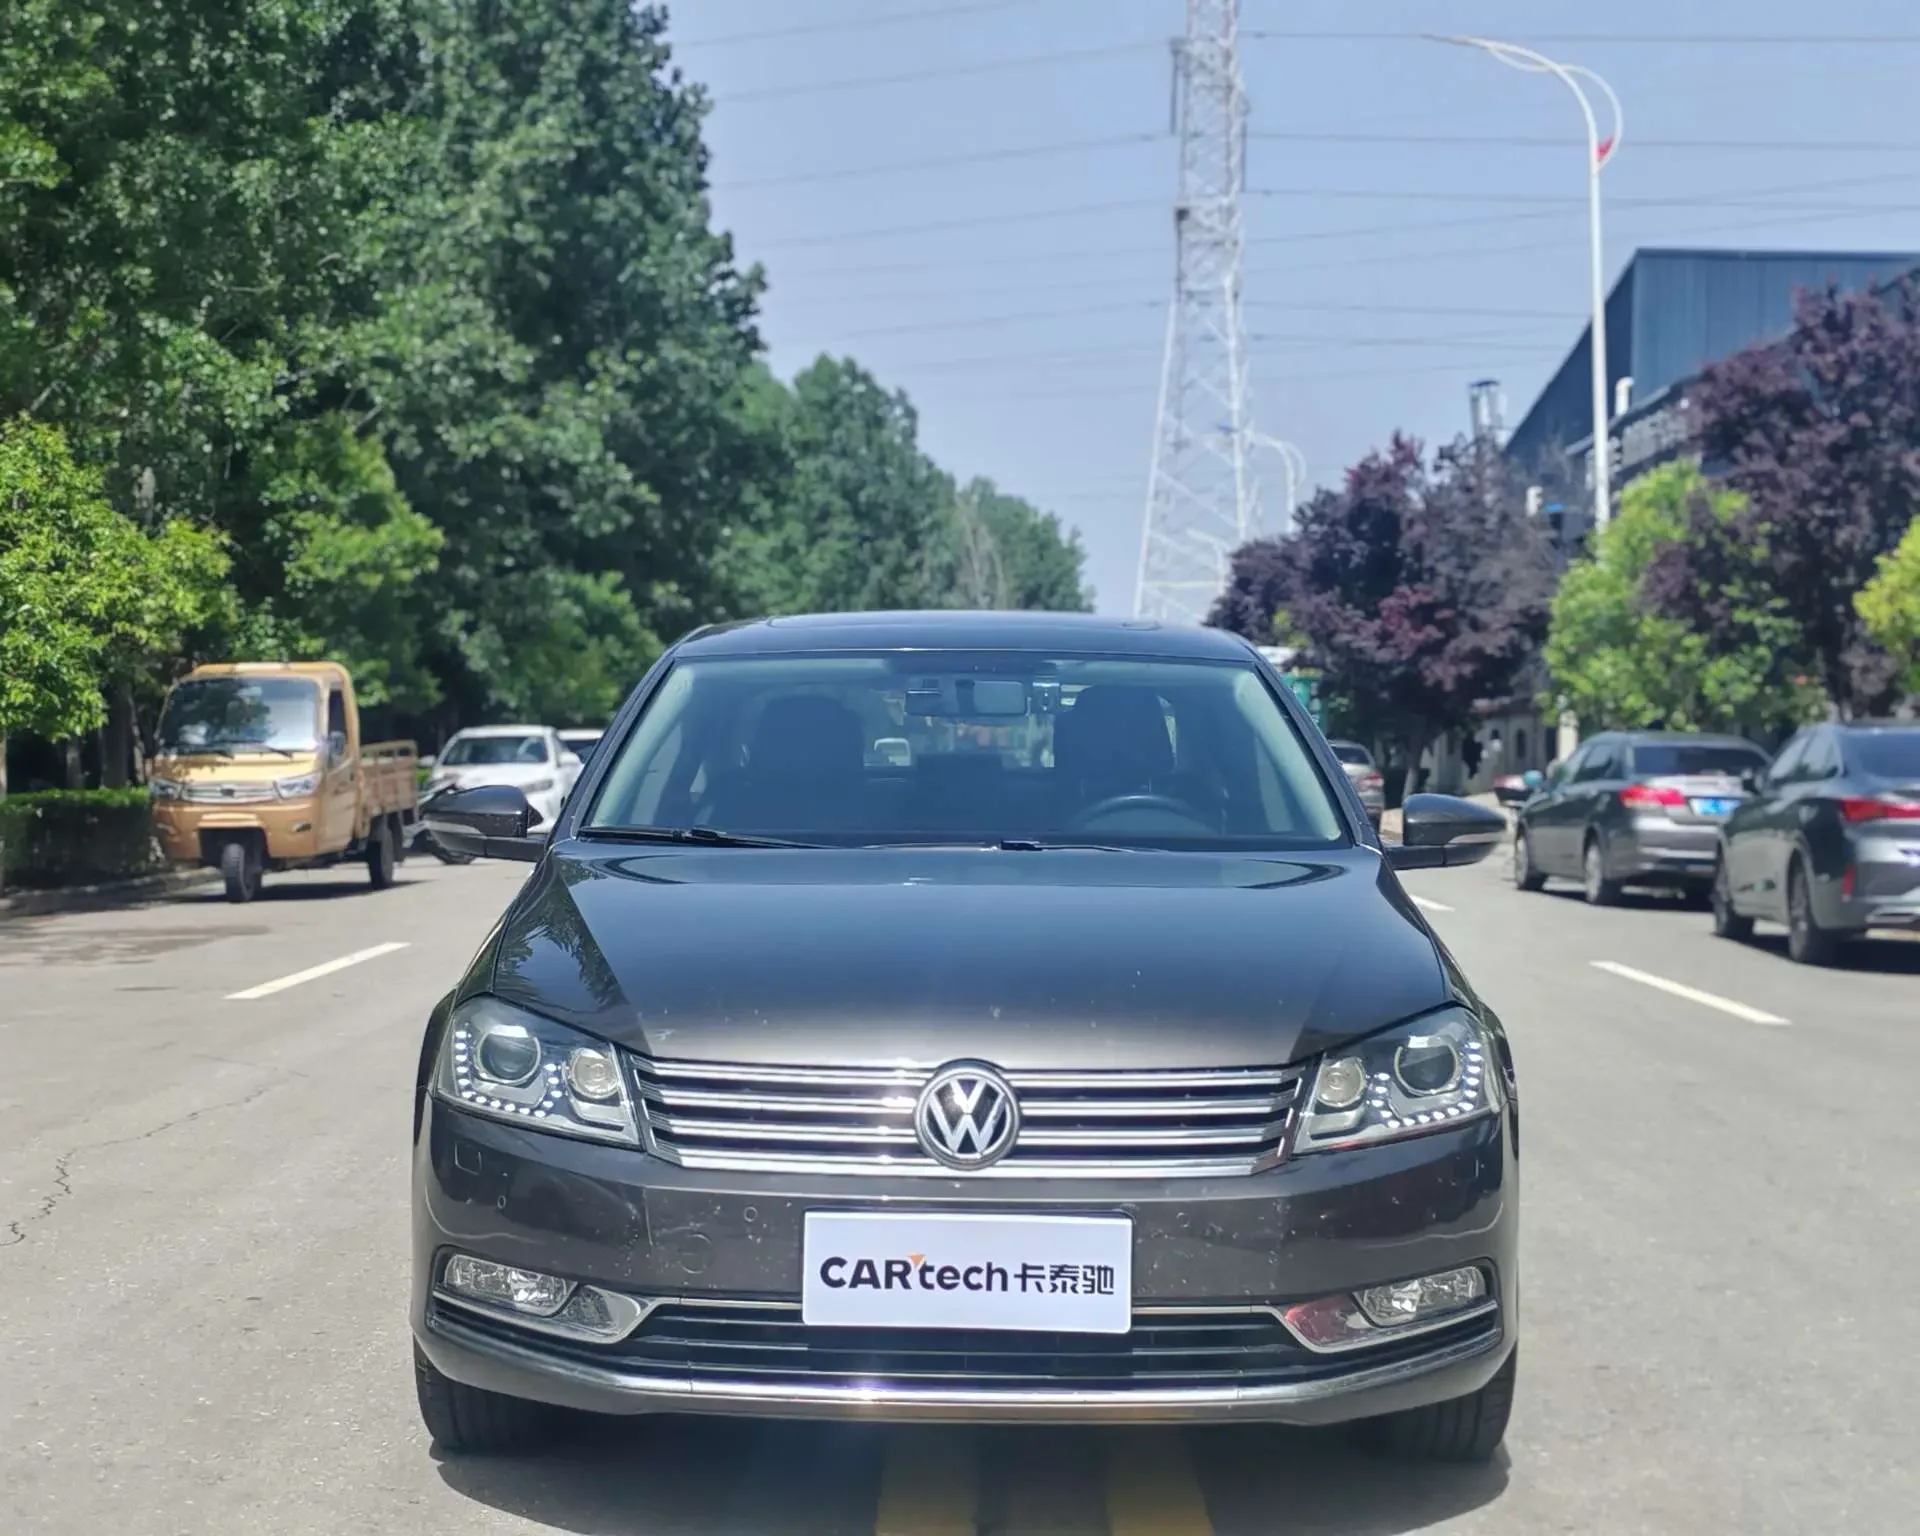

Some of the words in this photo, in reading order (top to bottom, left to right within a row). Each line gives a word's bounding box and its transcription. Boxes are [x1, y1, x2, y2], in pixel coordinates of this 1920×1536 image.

[820, 1256, 1009, 1292] CARtech
[1014, 1263, 1115, 1295] 卡泰驰
